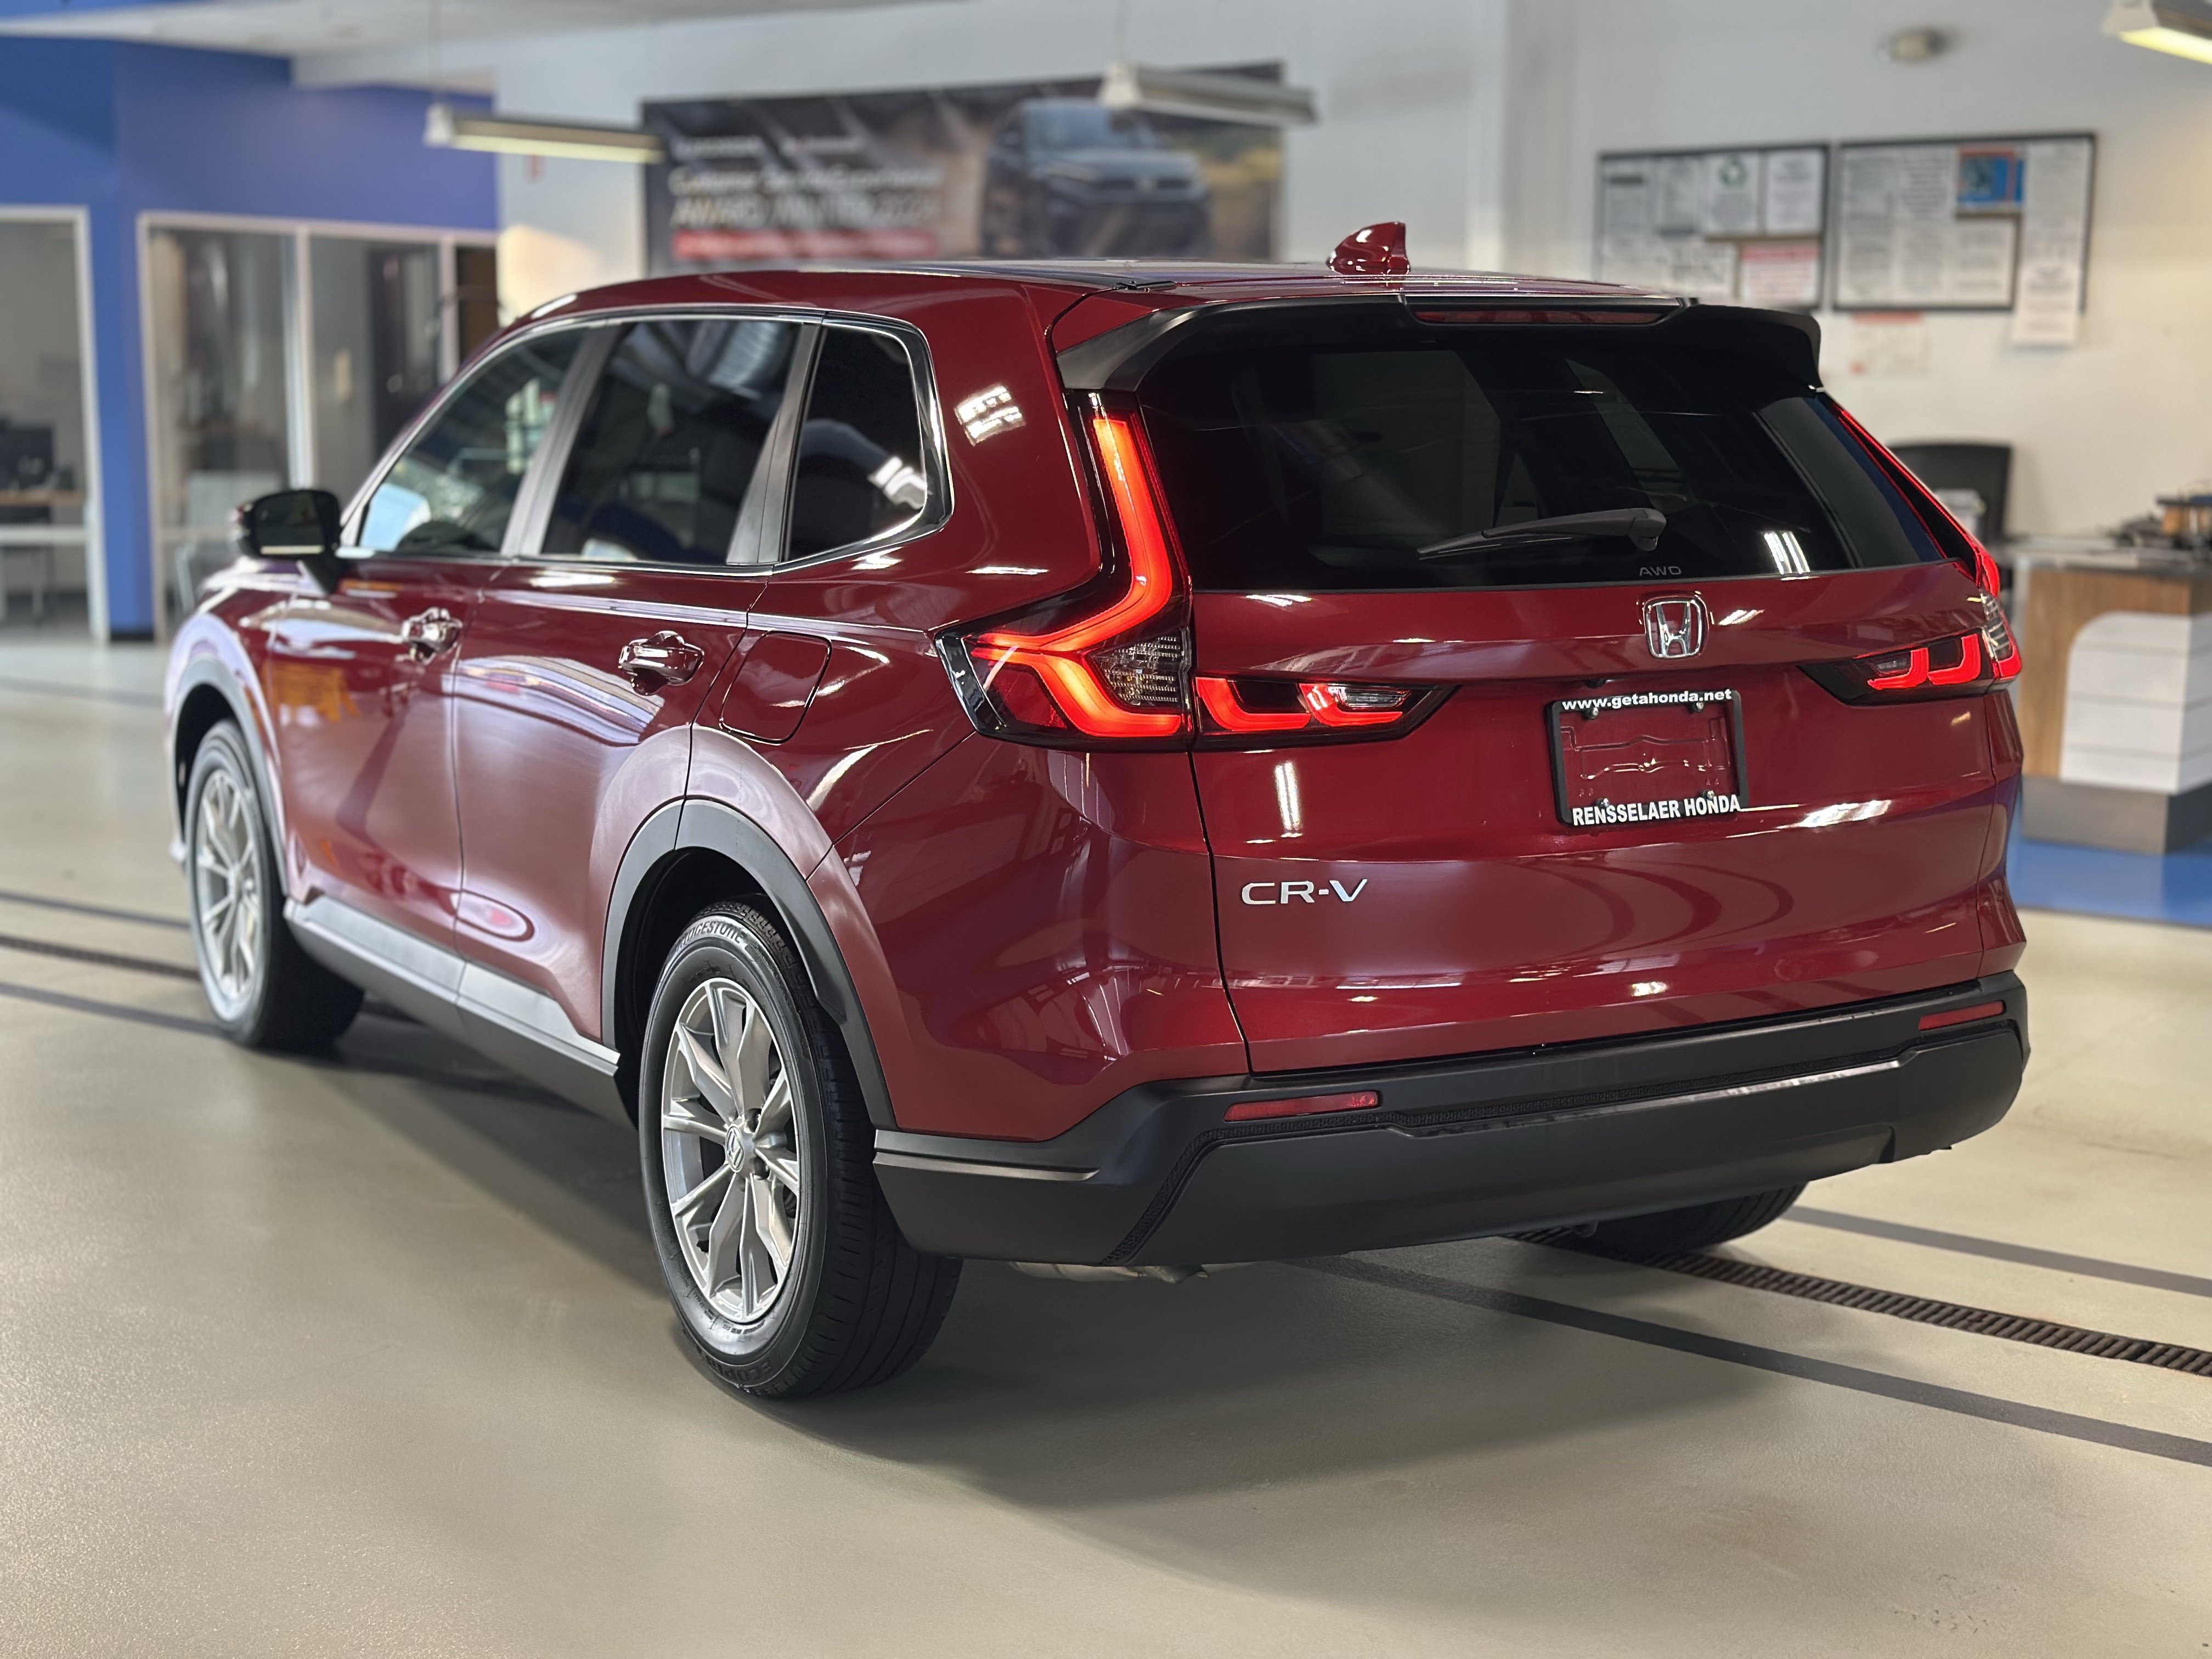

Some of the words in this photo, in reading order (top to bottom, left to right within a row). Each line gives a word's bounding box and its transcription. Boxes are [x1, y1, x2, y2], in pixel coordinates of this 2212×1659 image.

[1639, 566, 1682, 576] AWD
[1562, 689, 1732, 710] www.getahonda.net
[1572, 803, 1680, 826] RENSSELAER
[1684, 794, 1741, 815] HONDA
[1241, 878, 1368, 905] CR-V
